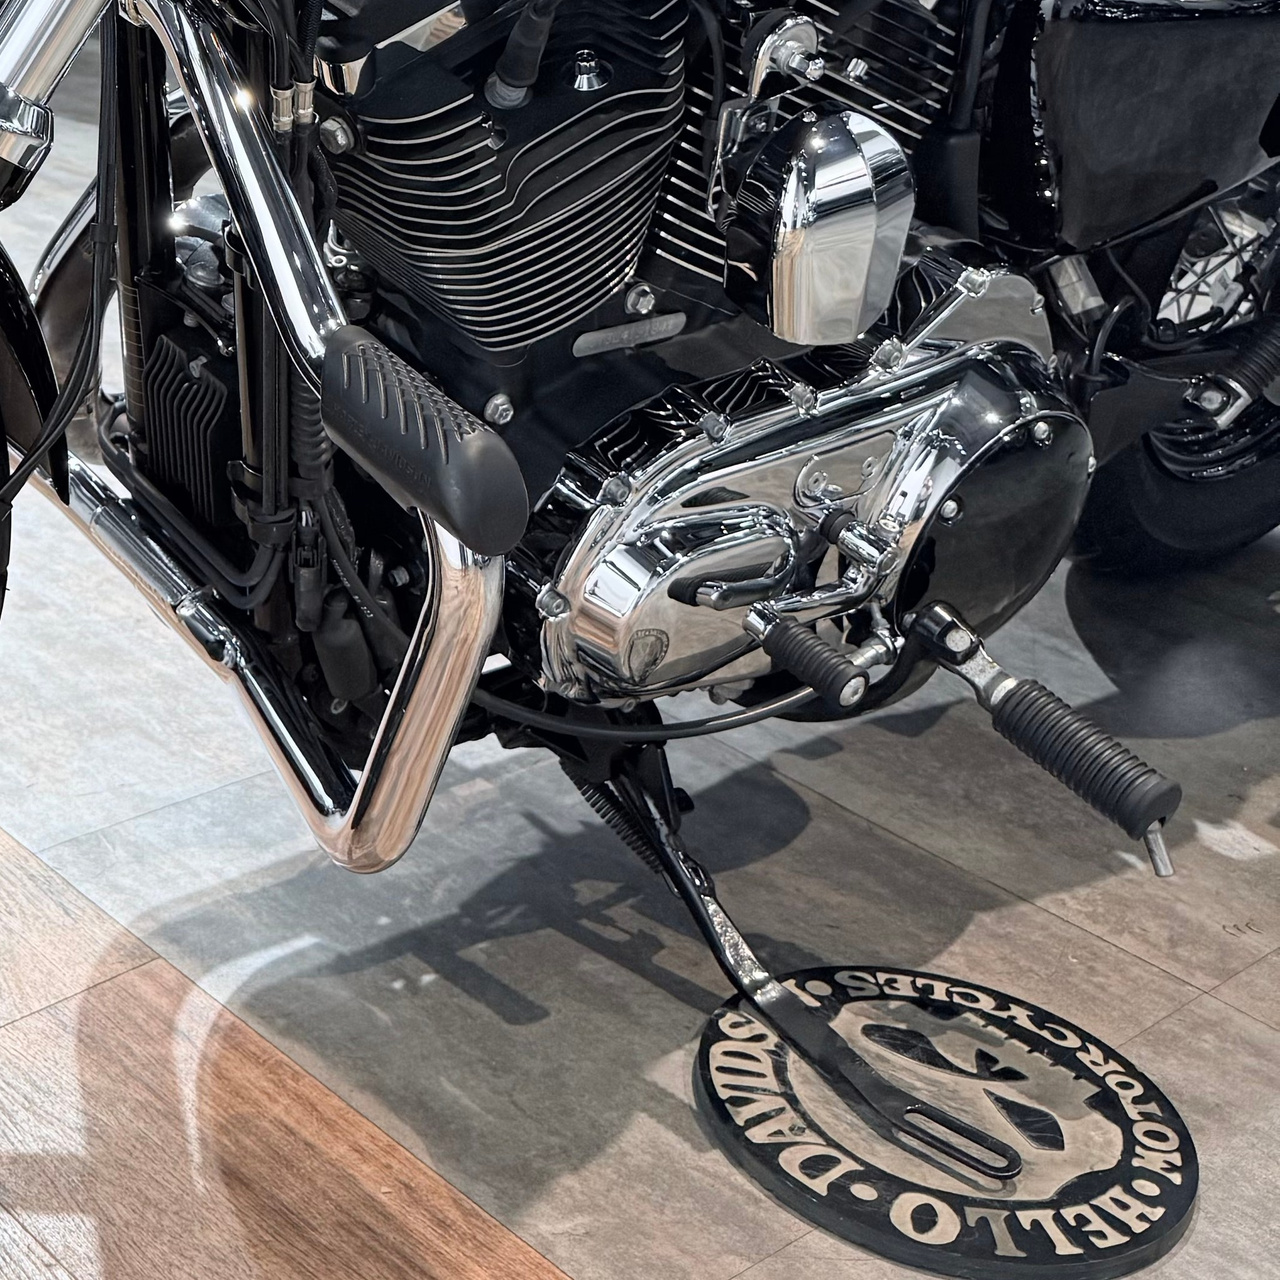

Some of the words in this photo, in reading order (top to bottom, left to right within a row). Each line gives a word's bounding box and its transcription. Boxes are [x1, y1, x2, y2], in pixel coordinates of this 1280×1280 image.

[708, 977, 864, 1196] DAVIDS
[832, 970, 1182, 1186] MOTORCYCLES
[889, 1185, 1166, 1258] HELLO
